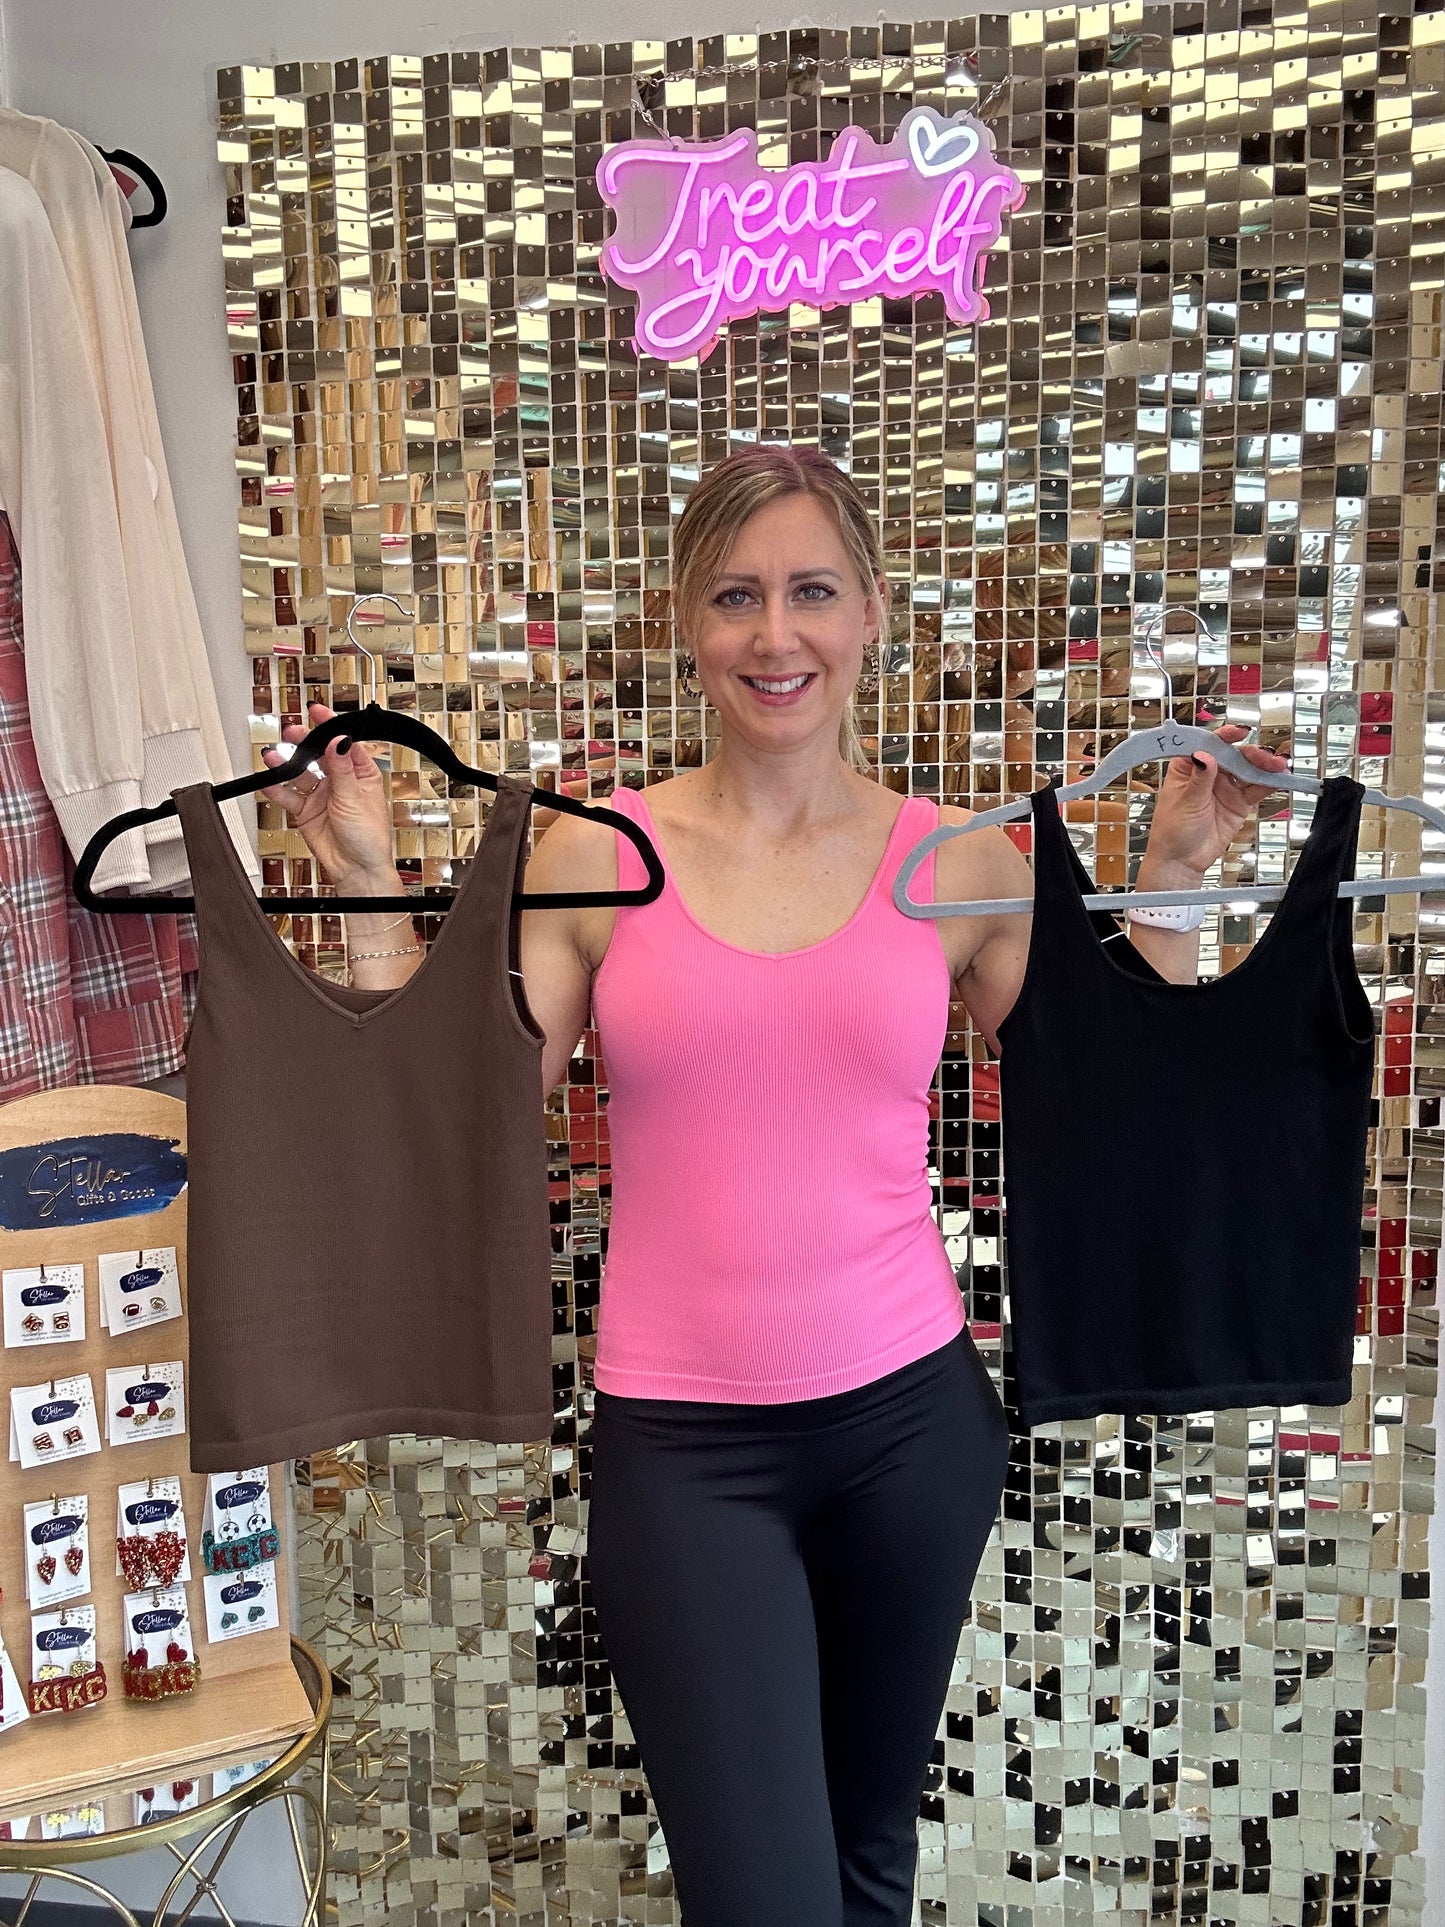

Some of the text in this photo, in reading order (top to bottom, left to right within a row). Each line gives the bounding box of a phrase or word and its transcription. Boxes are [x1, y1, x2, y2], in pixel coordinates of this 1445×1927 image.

[606, 136, 910, 274] Treat
[645, 171, 1013, 349] yourself
[77, 1193, 105, 1206] Gifts
